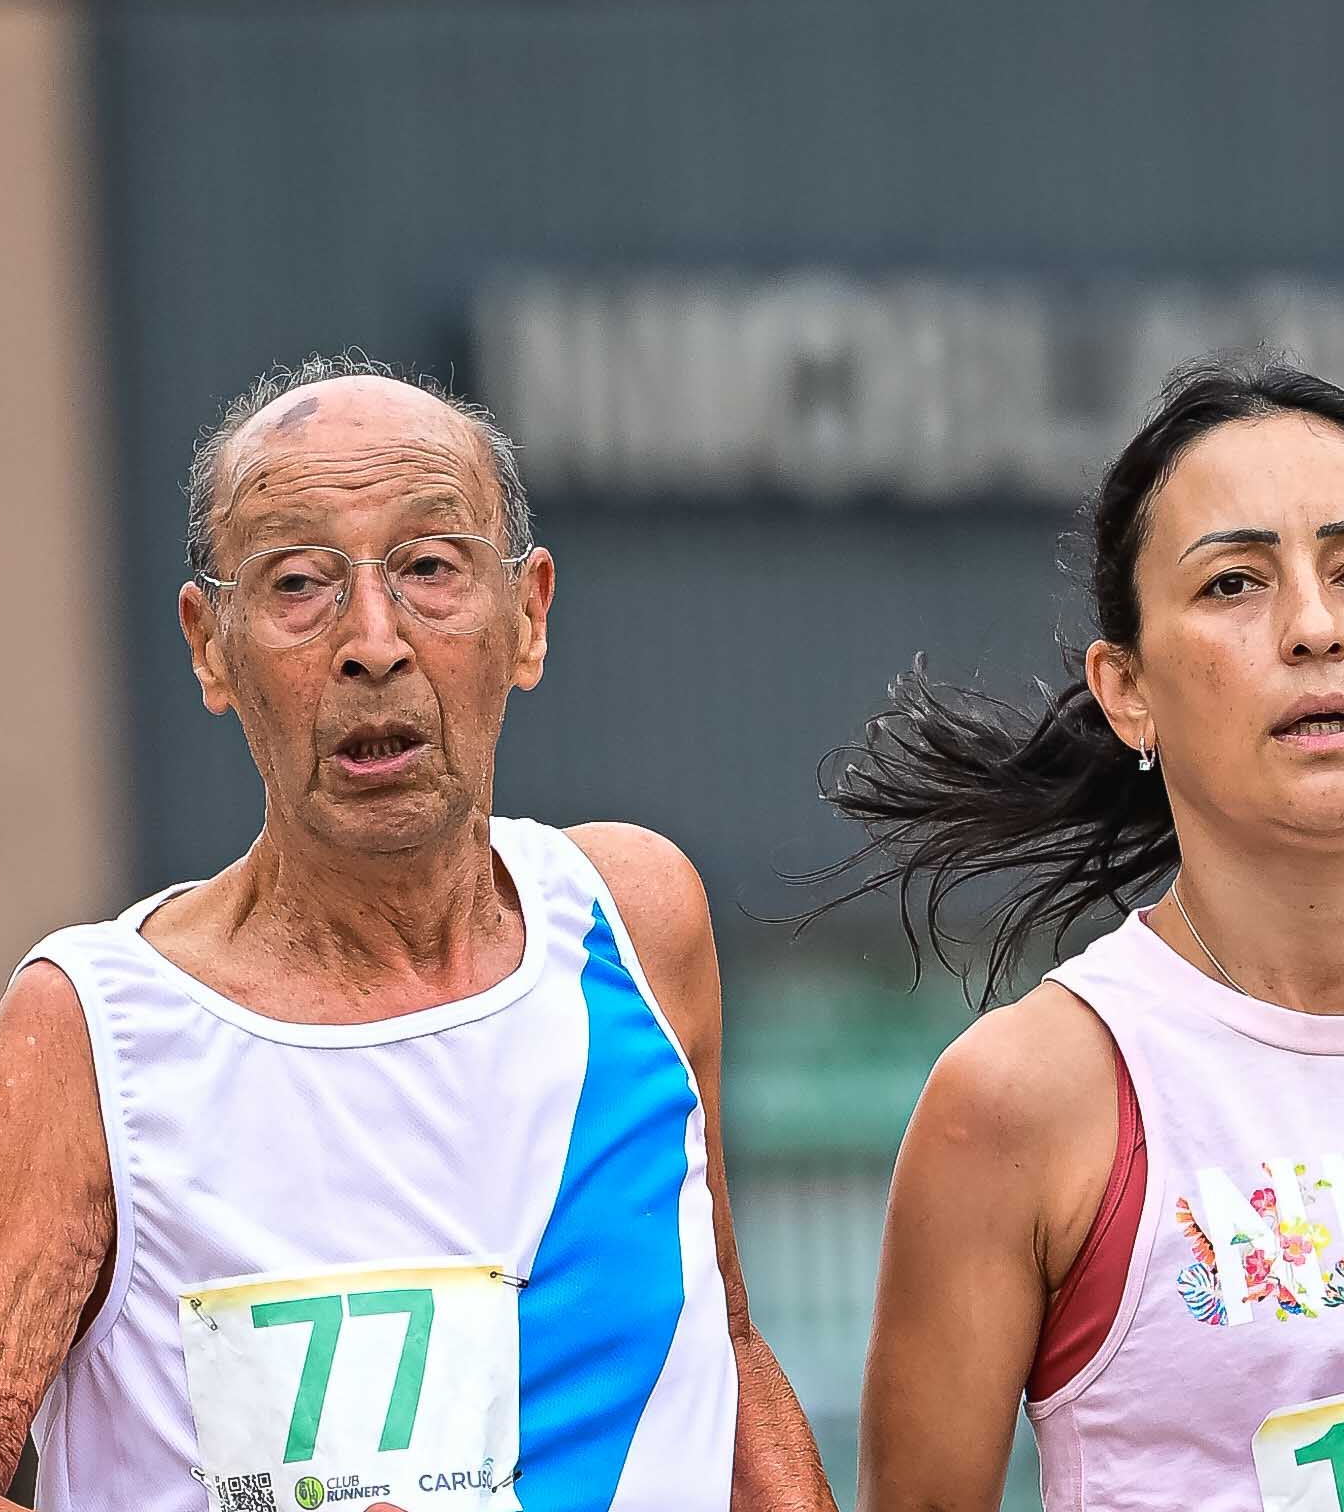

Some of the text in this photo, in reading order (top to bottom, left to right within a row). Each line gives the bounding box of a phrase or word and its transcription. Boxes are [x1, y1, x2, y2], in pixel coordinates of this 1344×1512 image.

[251, 1288, 435, 1465] 77
[326, 1474, 360, 1489] CLUB
[326, 1484, 391, 1503] RUNNER'S
